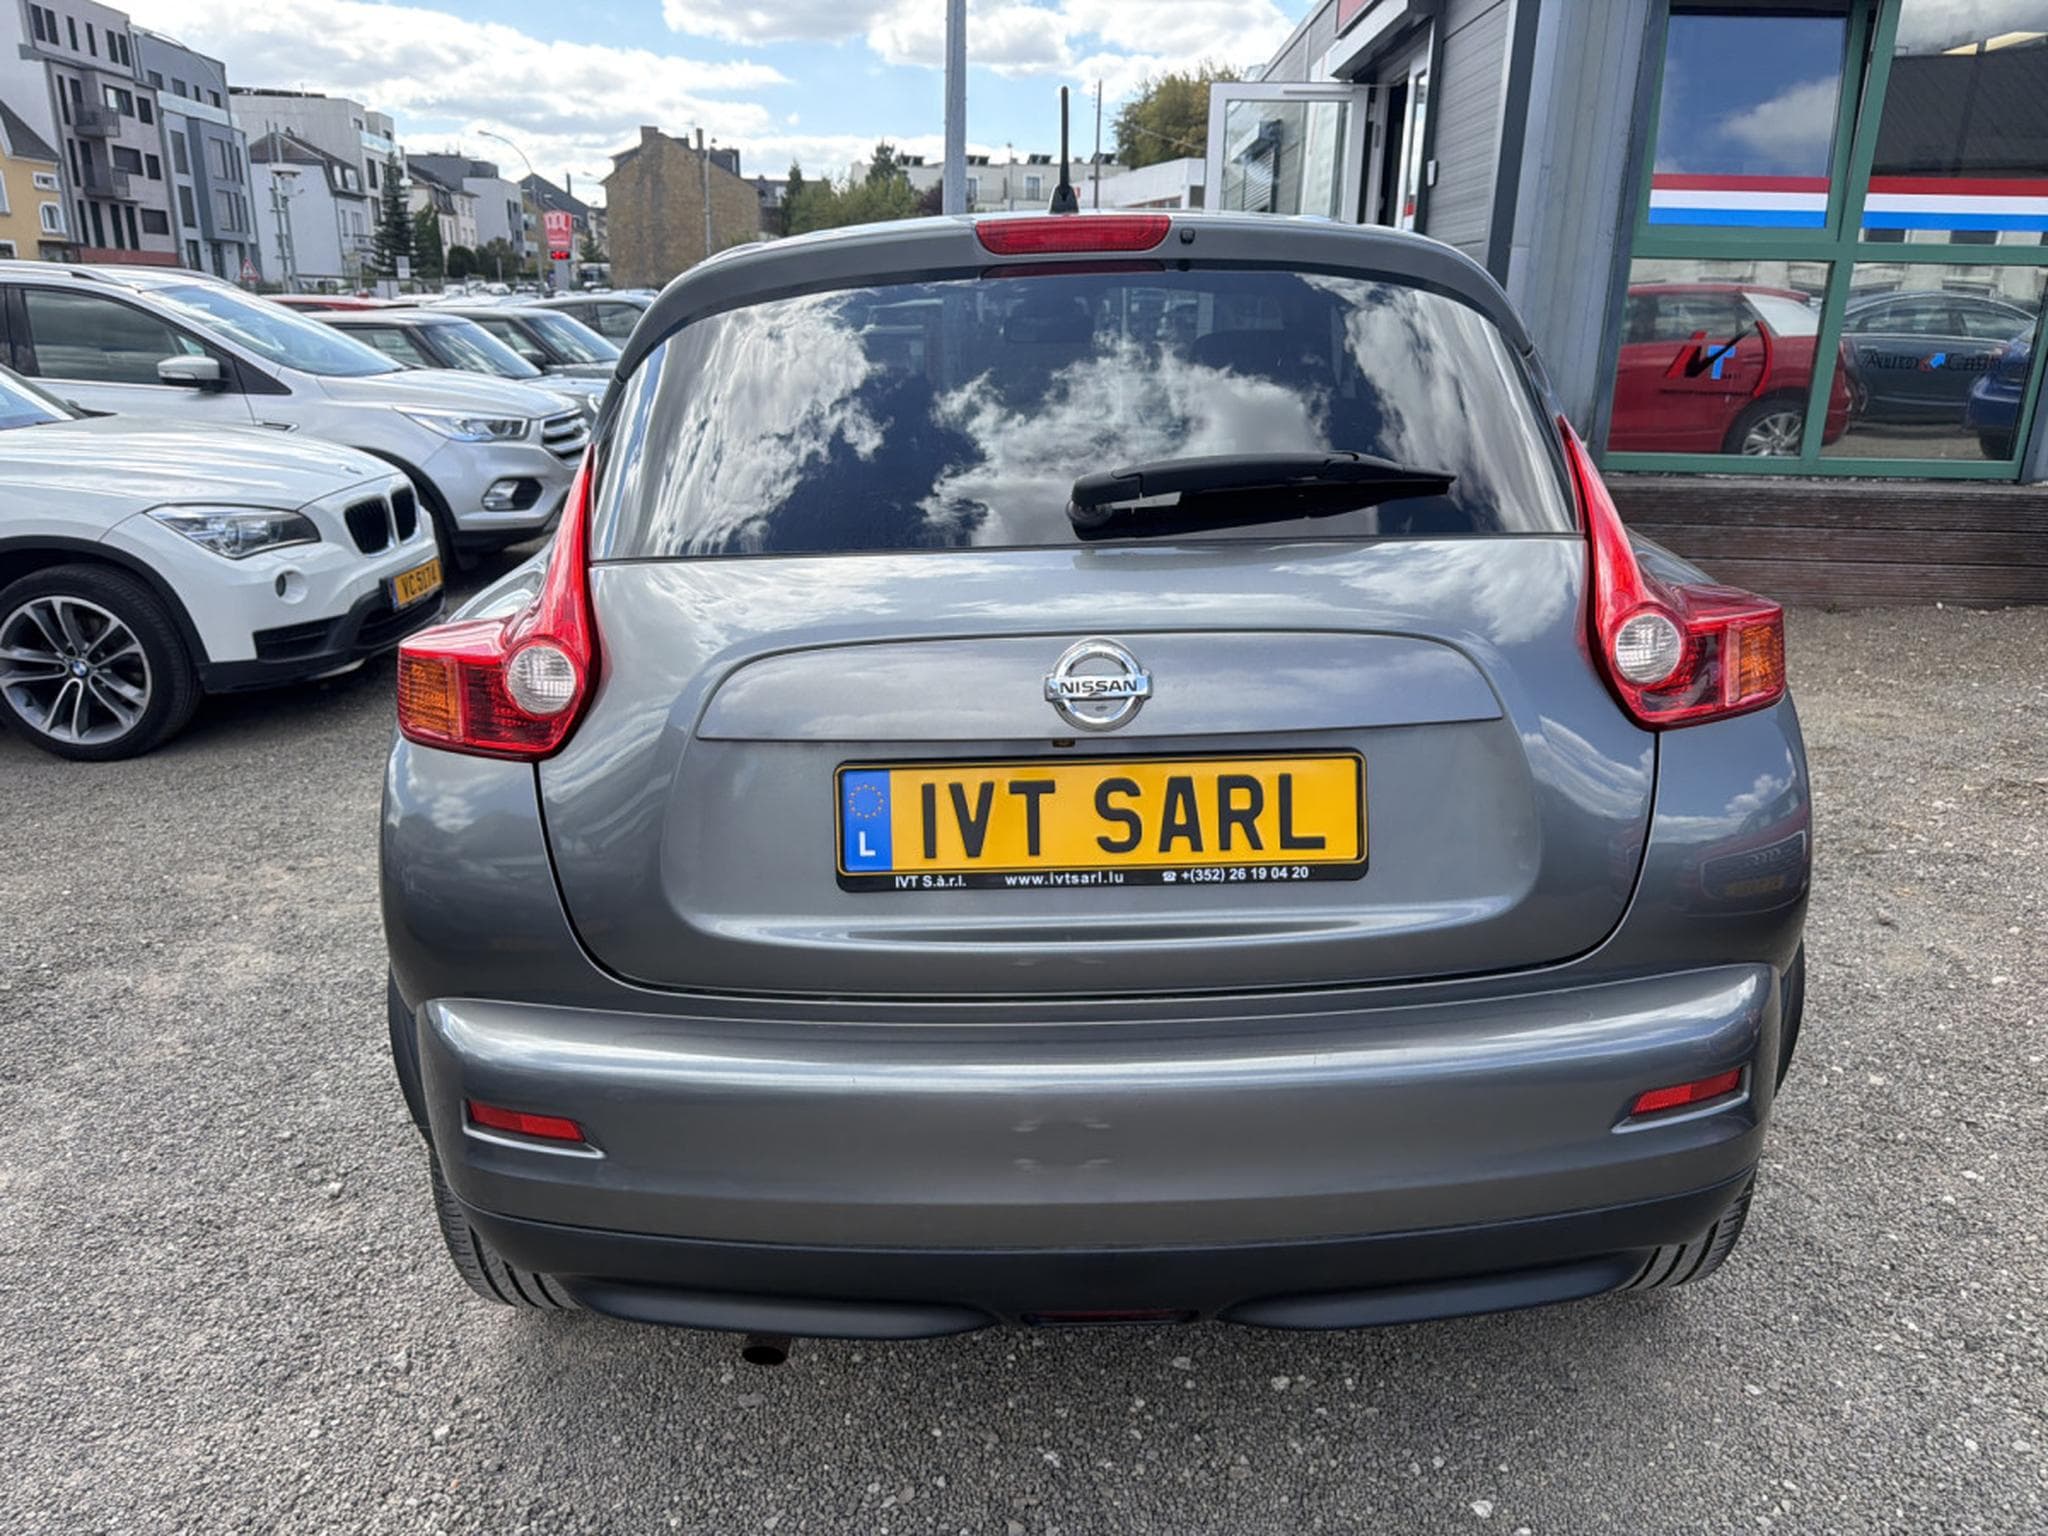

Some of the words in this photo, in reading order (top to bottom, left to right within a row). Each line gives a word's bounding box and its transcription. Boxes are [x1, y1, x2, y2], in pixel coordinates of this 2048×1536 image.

[1863, 351, 1918, 370] Auto
[1060, 679, 1138, 694] NISSAN
[921, 779, 1056, 859] IVT
[1094, 772, 1326, 854] SARL
[858, 830, 876, 857] L
[895, 875, 919, 889] IVT
[1004, 869, 1124, 886] www.ivtsarl.lu
[1181, 868, 1225, 884] +(352)
[1229, 868, 1246, 881] 26
[1250, 867, 1267, 880] 19
[1270, 866, 1288, 879] 04
[1291, 866, 1309, 879] 20
